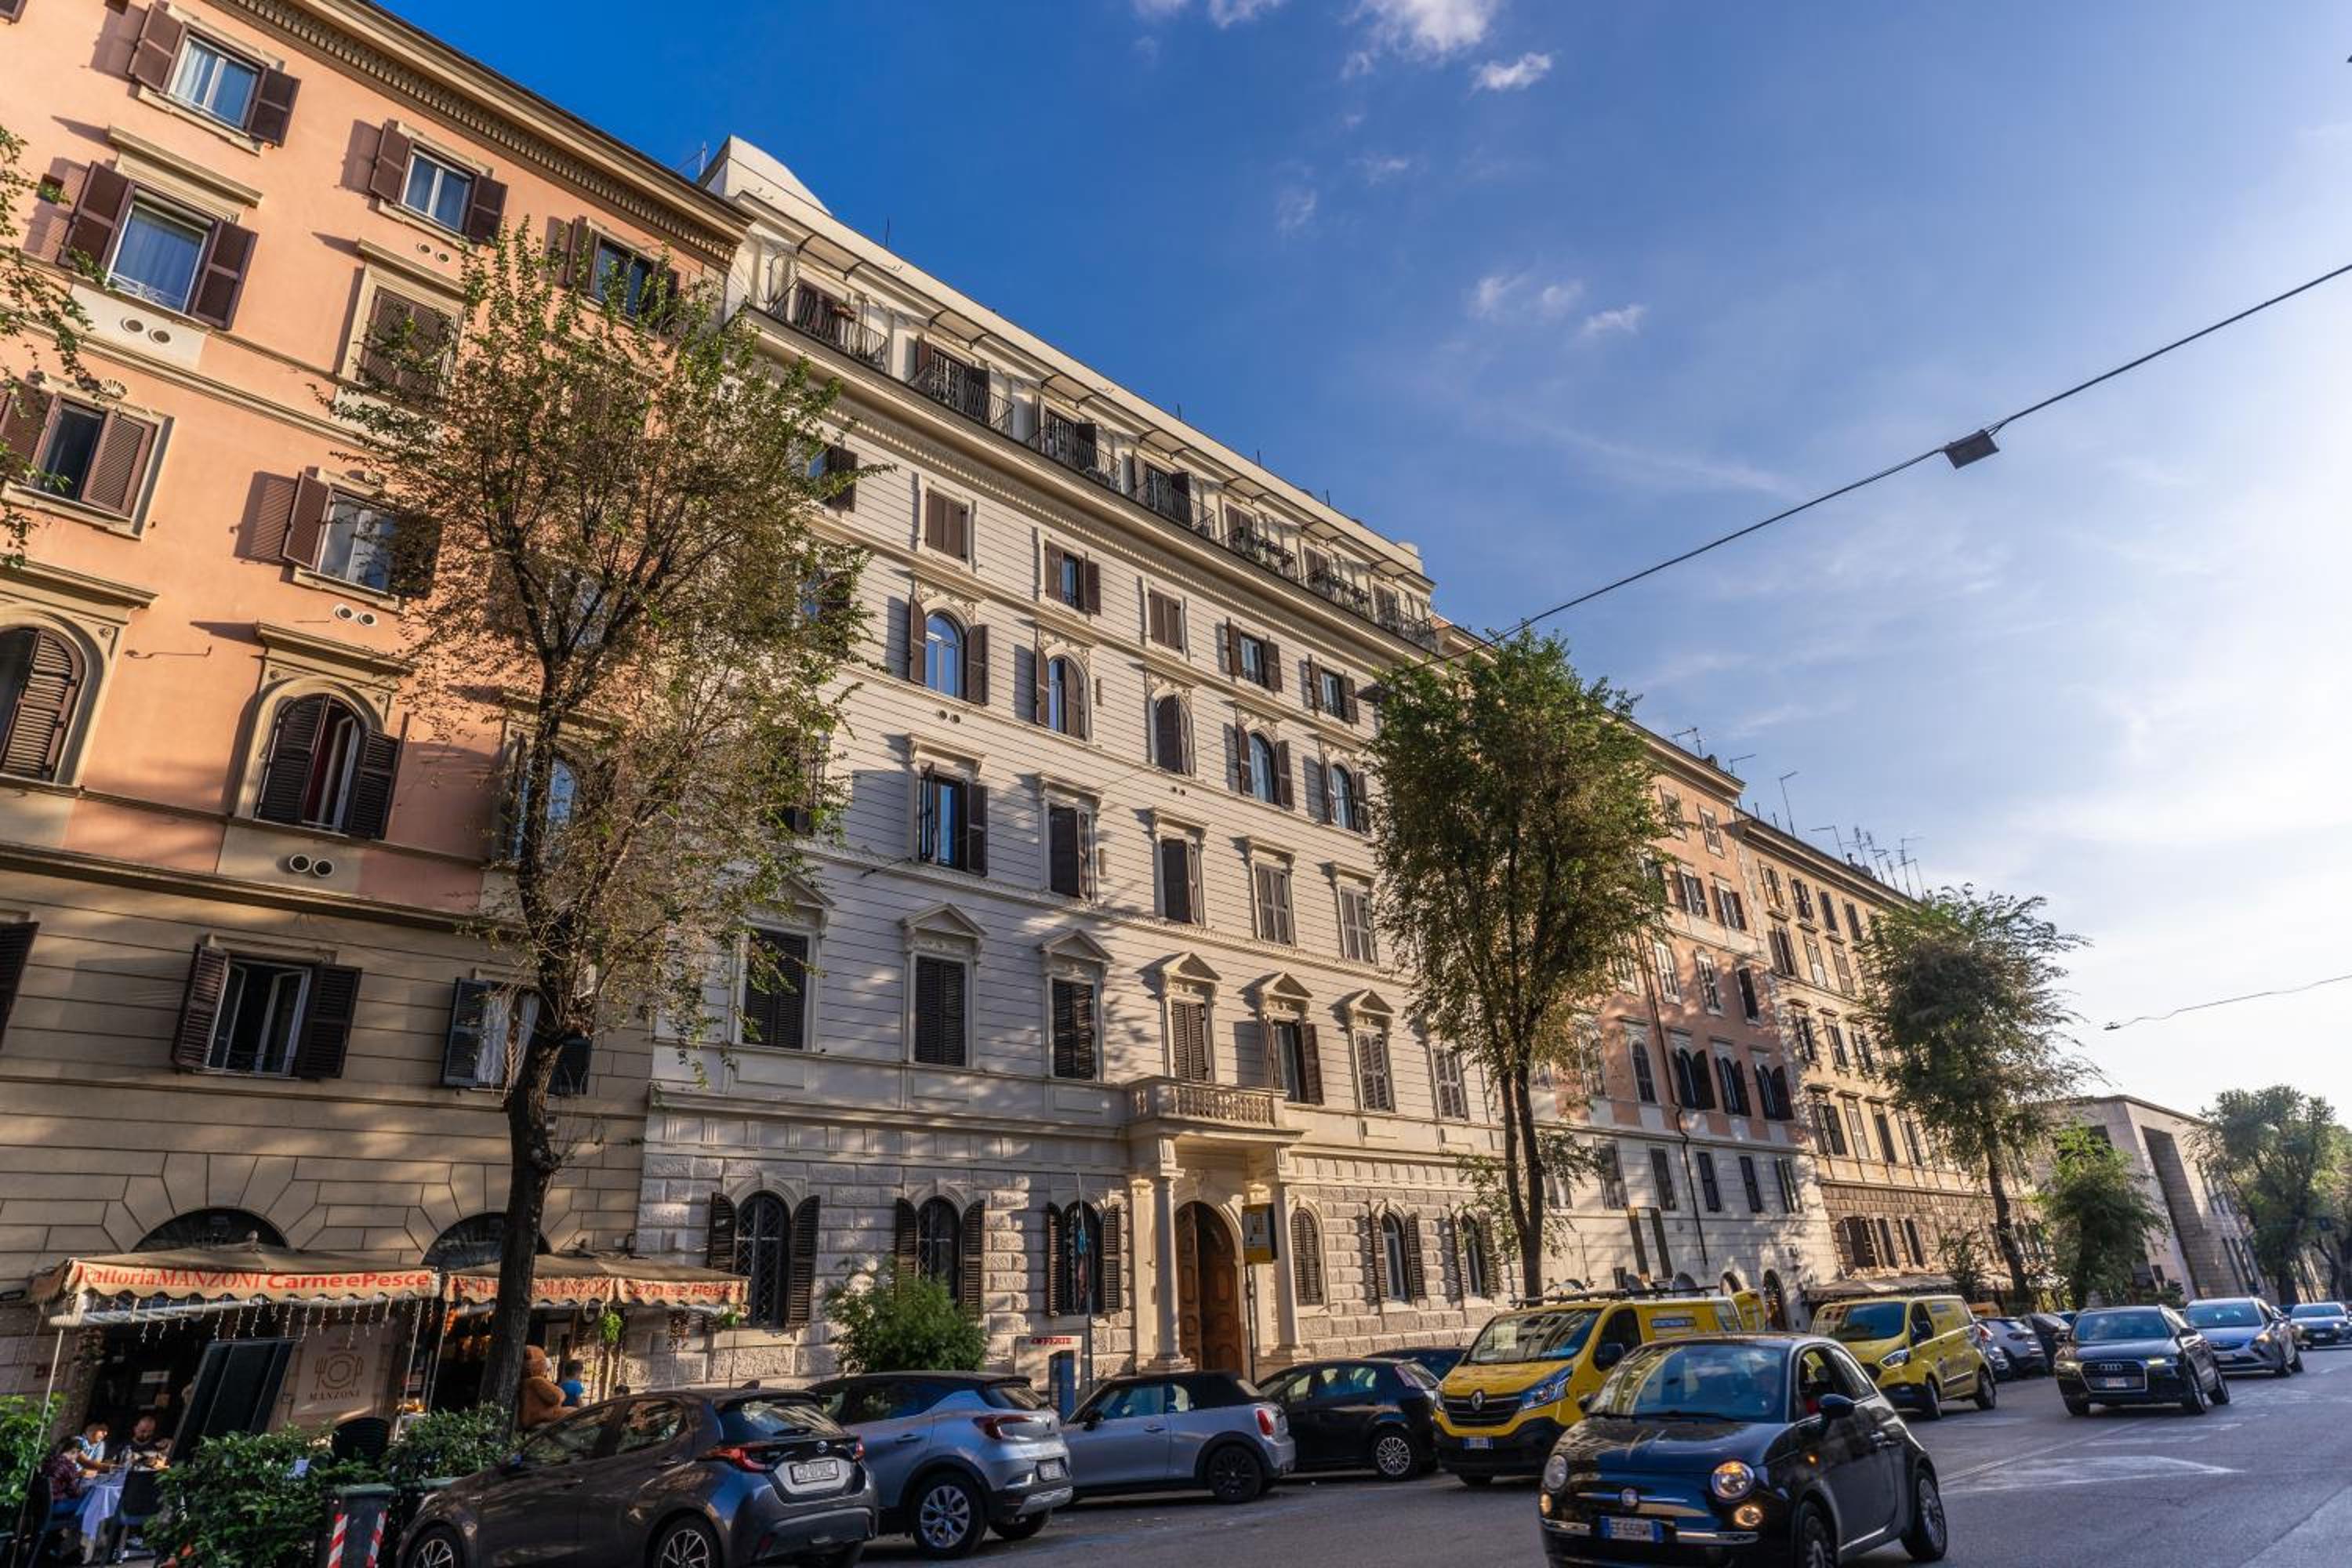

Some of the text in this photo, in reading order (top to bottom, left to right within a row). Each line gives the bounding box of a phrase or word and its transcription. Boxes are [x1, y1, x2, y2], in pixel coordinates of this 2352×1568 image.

[156, 1269, 262, 1288] MANZONI
[267, 1272, 343, 1289] Carne
[361, 1272, 430, 1287] Pesce
